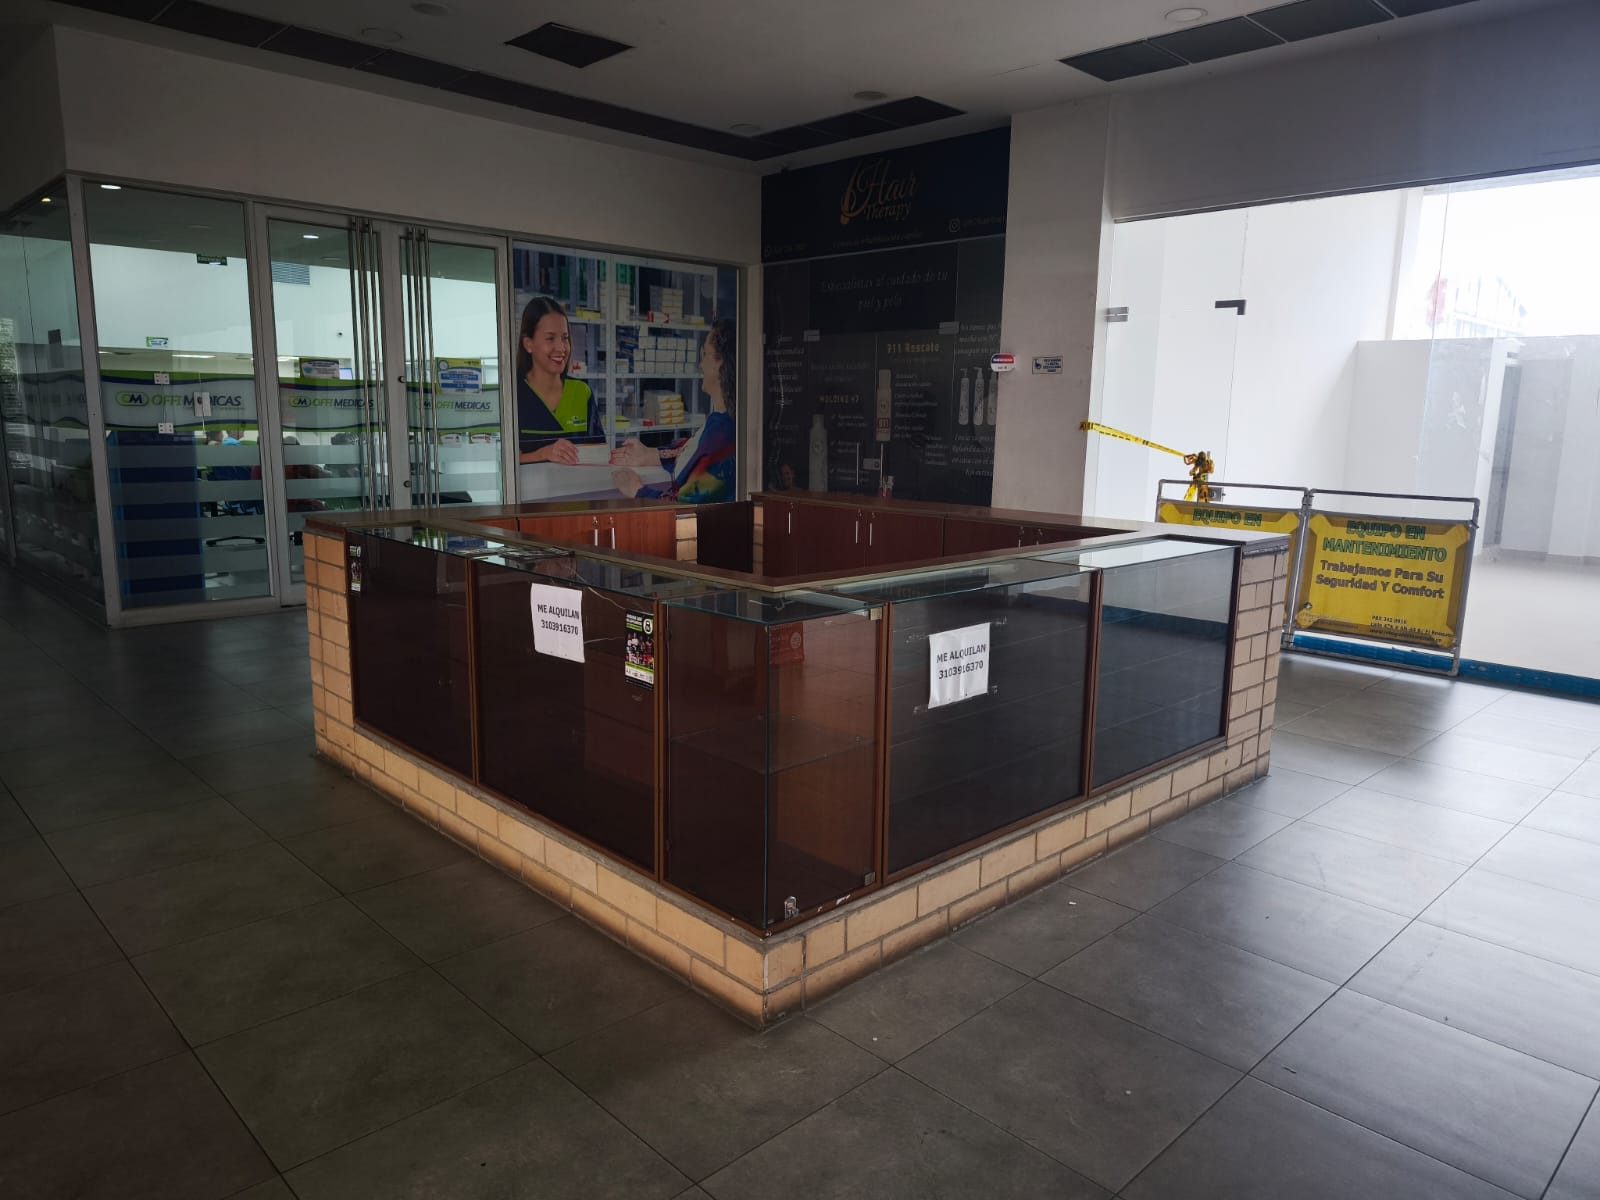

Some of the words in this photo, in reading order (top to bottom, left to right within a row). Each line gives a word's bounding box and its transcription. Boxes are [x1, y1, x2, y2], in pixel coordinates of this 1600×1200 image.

[857, 159, 918, 206] Hair
[864, 201, 912, 221] Therapy
[1193, 508, 1241, 525] EQUIPO
[1243, 513, 1262, 526] EN
[1346, 520, 1402, 538] EQUIPO
[1405, 525, 1426, 540] EN
[1322, 537, 1447, 562] MANTENIMIENTO
[1320, 560, 1392, 578] Trabajamos
[1394, 568, 1424, 581] Para
[1426, 571, 1444, 583] Su
[1316, 574, 1377, 592] Seguridad
[1380, 582, 1389, 592] Y
[1392, 583, 1445, 599] Comfort
[537, 604, 548, 614] ME
[549, 606, 579, 619] ALQUILAN
[540, 619, 579, 635] 3103916370
[936, 652, 948, 663] ME
[949, 644, 987, 661] ALQUILAN
[938, 660, 984, 680] 3103916370
